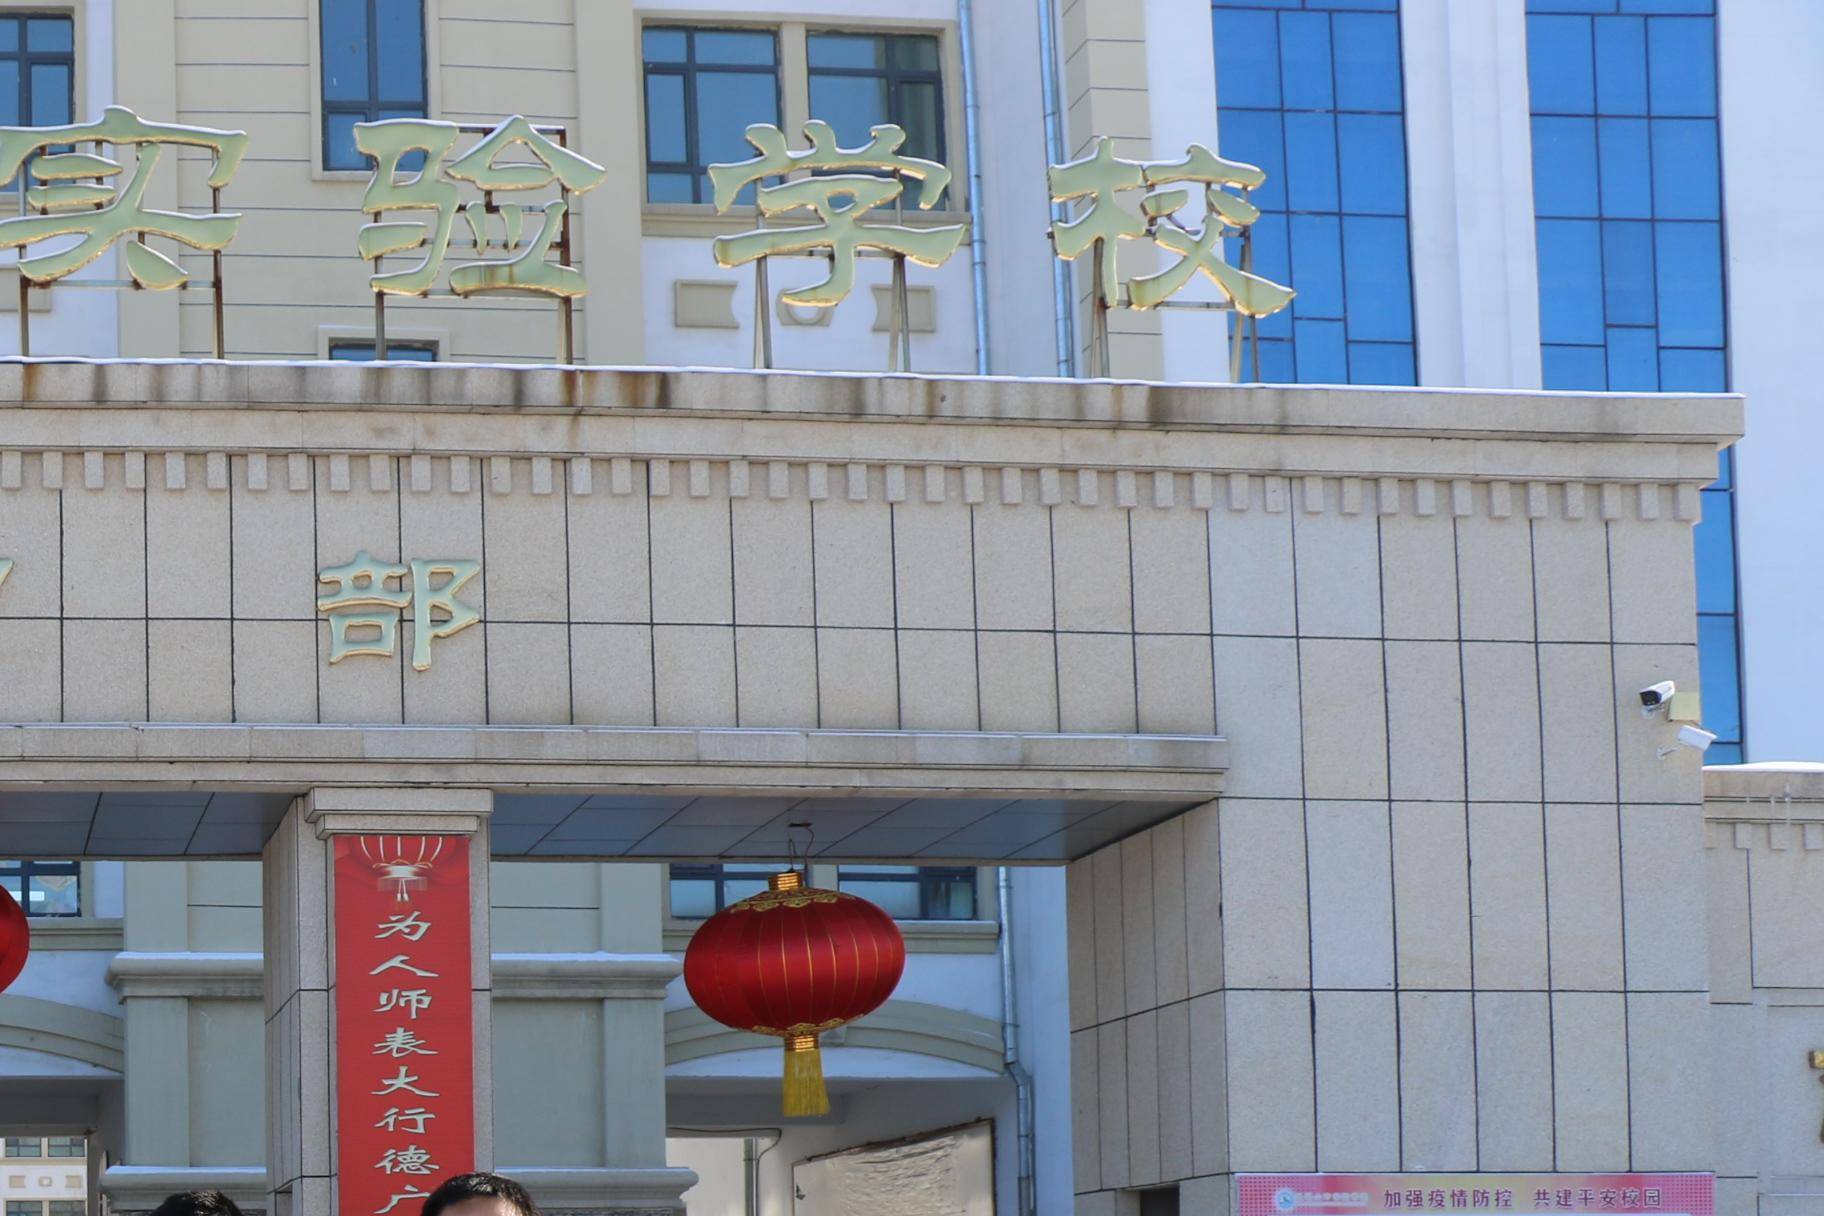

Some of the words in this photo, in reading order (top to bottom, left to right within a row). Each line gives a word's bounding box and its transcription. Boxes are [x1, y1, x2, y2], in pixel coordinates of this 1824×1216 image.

[1383, 1188, 1514, 1209] 加强疫情防控
[1533, 1187, 1662, 1208] 共建平安校园
